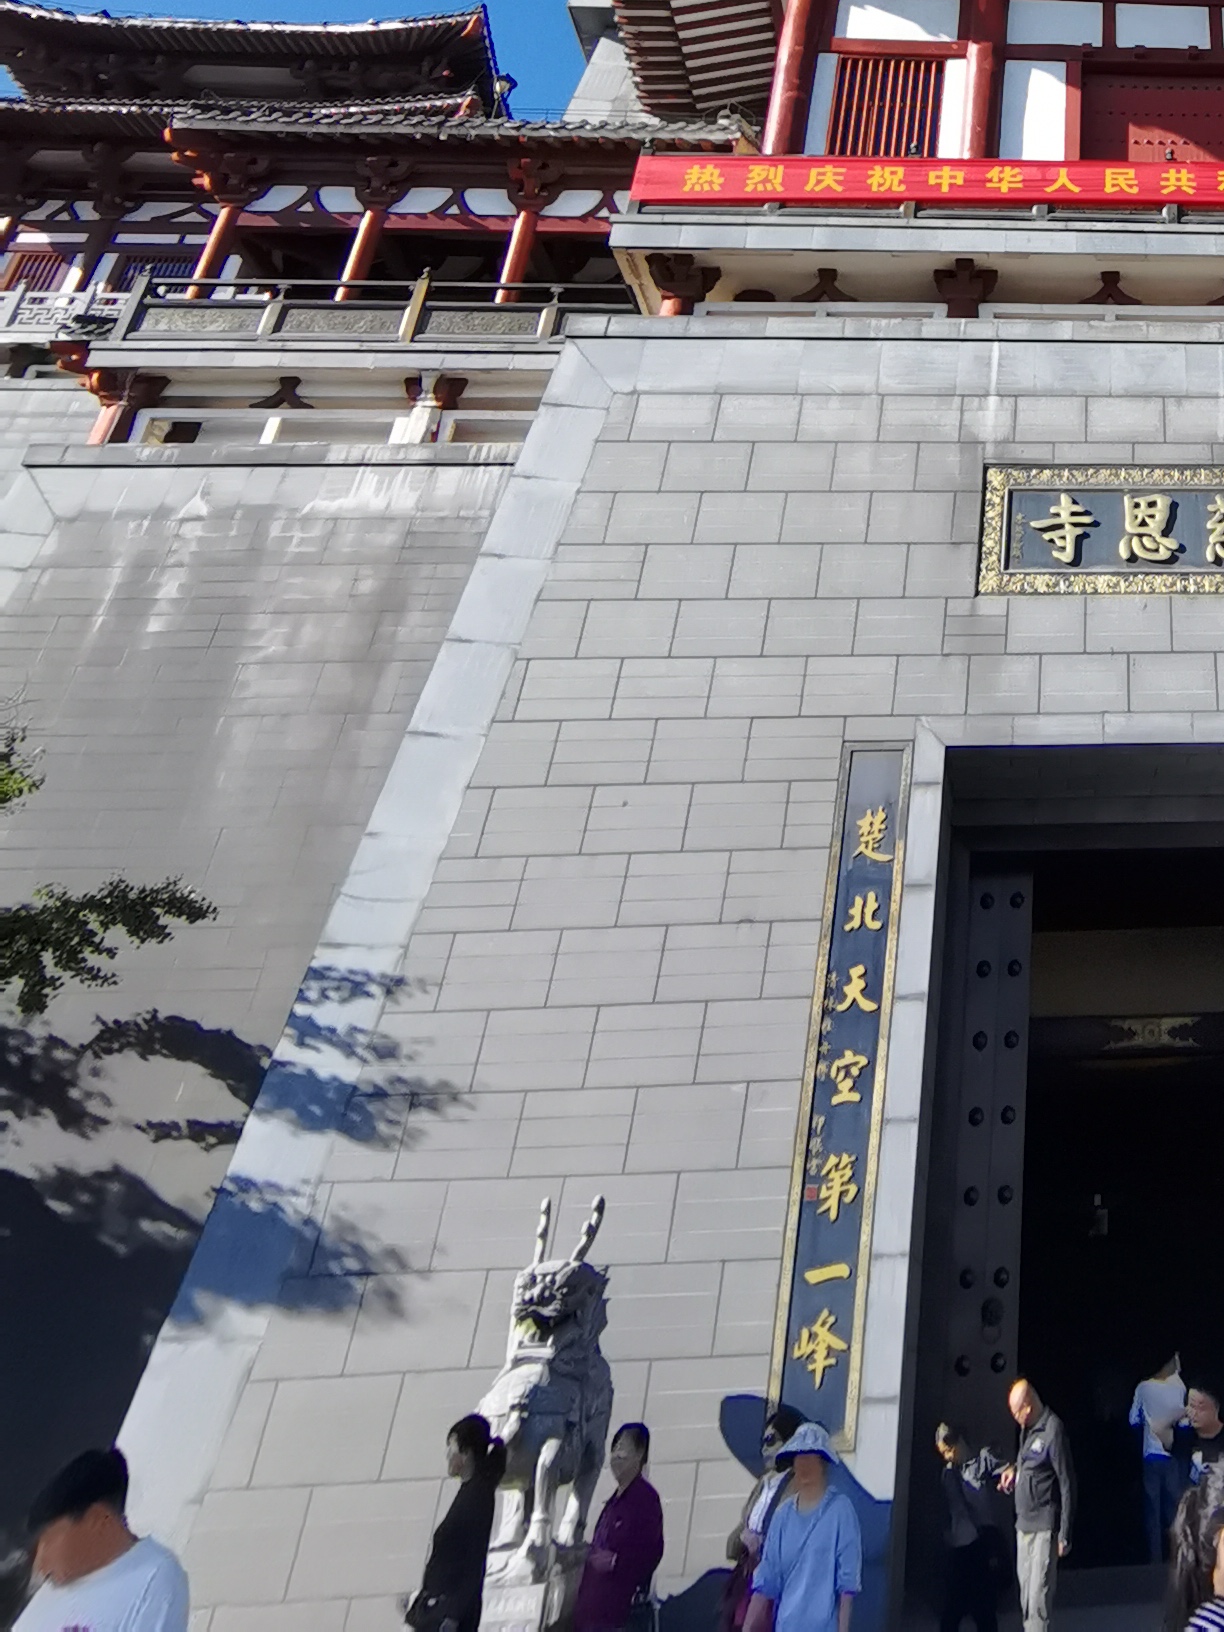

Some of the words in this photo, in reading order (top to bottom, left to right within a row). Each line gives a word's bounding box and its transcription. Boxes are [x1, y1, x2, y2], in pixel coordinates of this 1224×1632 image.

[794, 808, 894, 1390] 楚北天空第一峰
